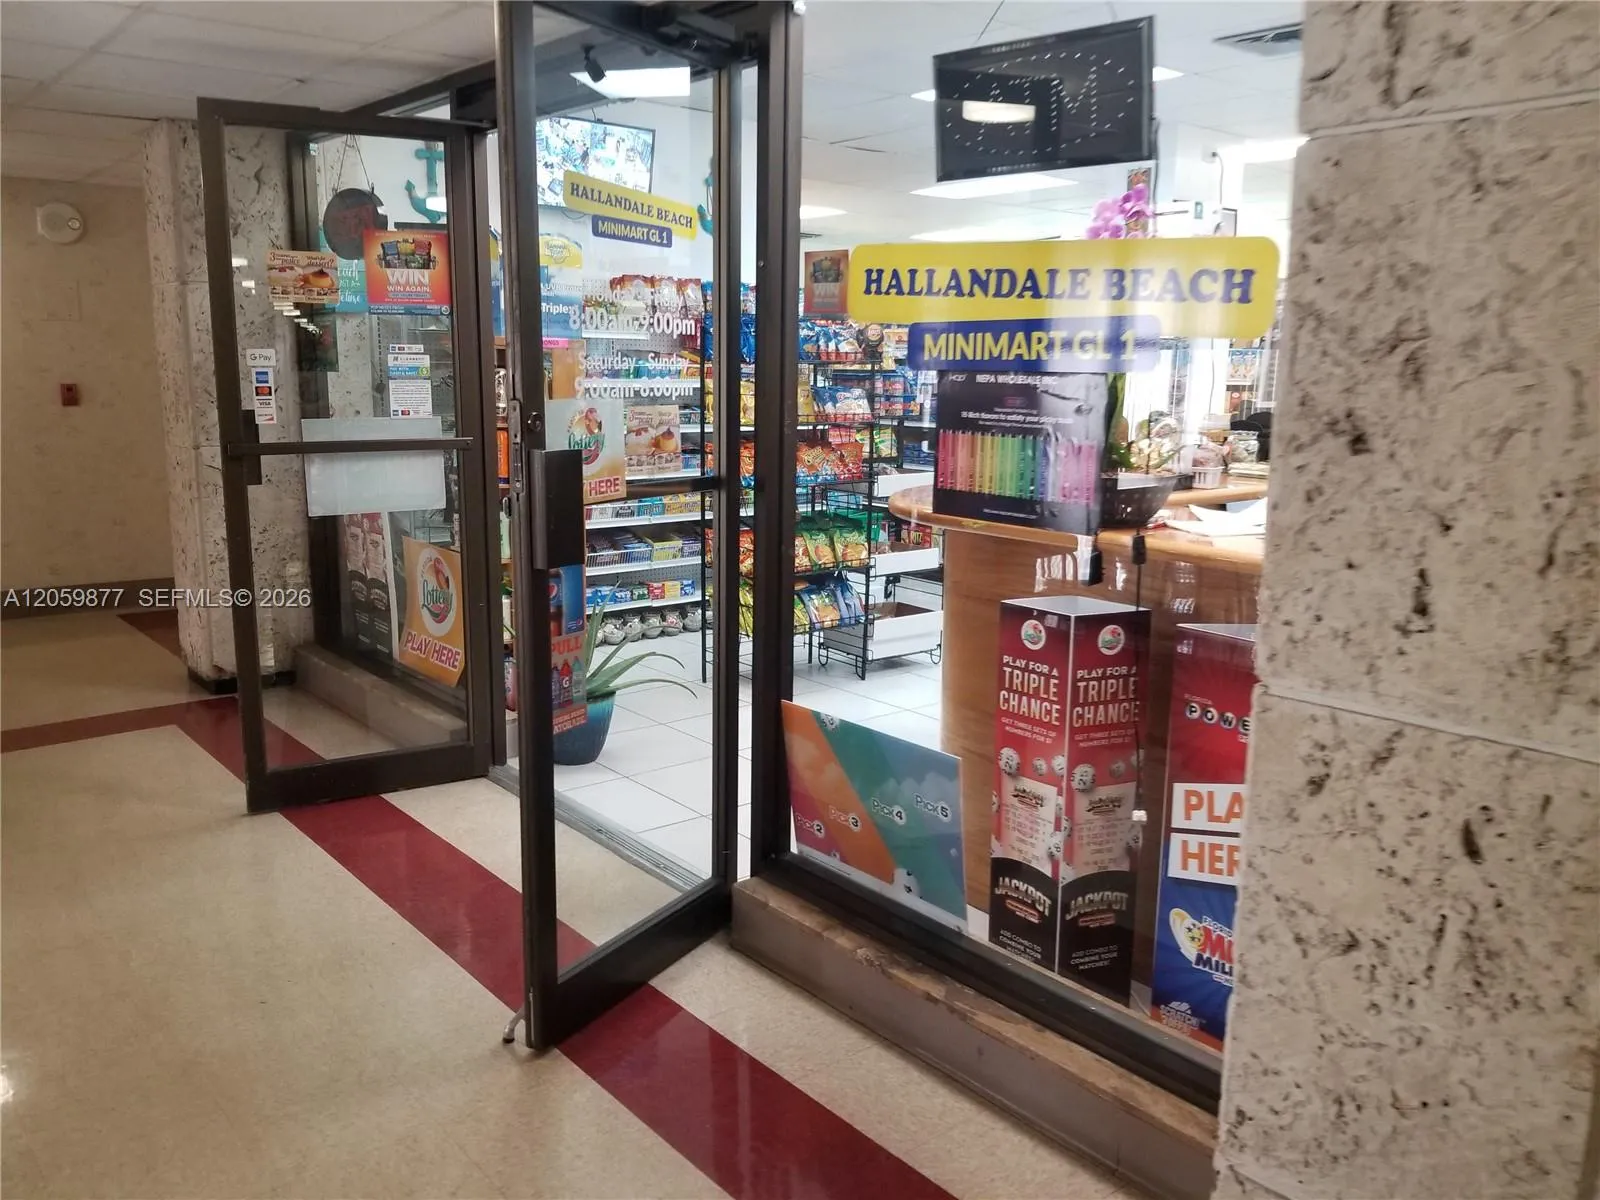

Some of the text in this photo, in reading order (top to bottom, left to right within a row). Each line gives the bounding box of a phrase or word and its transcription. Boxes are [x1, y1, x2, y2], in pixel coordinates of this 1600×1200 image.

[570, 182, 693, 229] HALLANDALE BEACH
[597, 220, 668, 244] MINIMART GL 1
[387, 269, 430, 286] WIN
[863, 268, 1256, 304] HALLANDALE BEACH
[259, 353, 271, 361] Pay
[923, 330, 1137, 362] MINIMART GL 1
[579, 352, 636, 371] Saturday
[648, 352, 690, 371] Sunday
[589, 477, 620, 496] HERE
[404, 632, 461, 670] PLAY HERE
[1003, 655, 1059, 677] PLAY FOR A
[1076, 668, 1103, 679] PLAY
[1106, 666, 1128, 677] FOR
[1003, 666, 1059, 701] TRIPLE
[1076, 677, 1138, 703] TRIPLE
[999, 690, 1060, 725] CHANCE
[1072, 701, 1140, 727] CHANCE
[994, 876, 1052, 917] JACKPOT
[1065, 891, 1128, 920] JACKPOT
